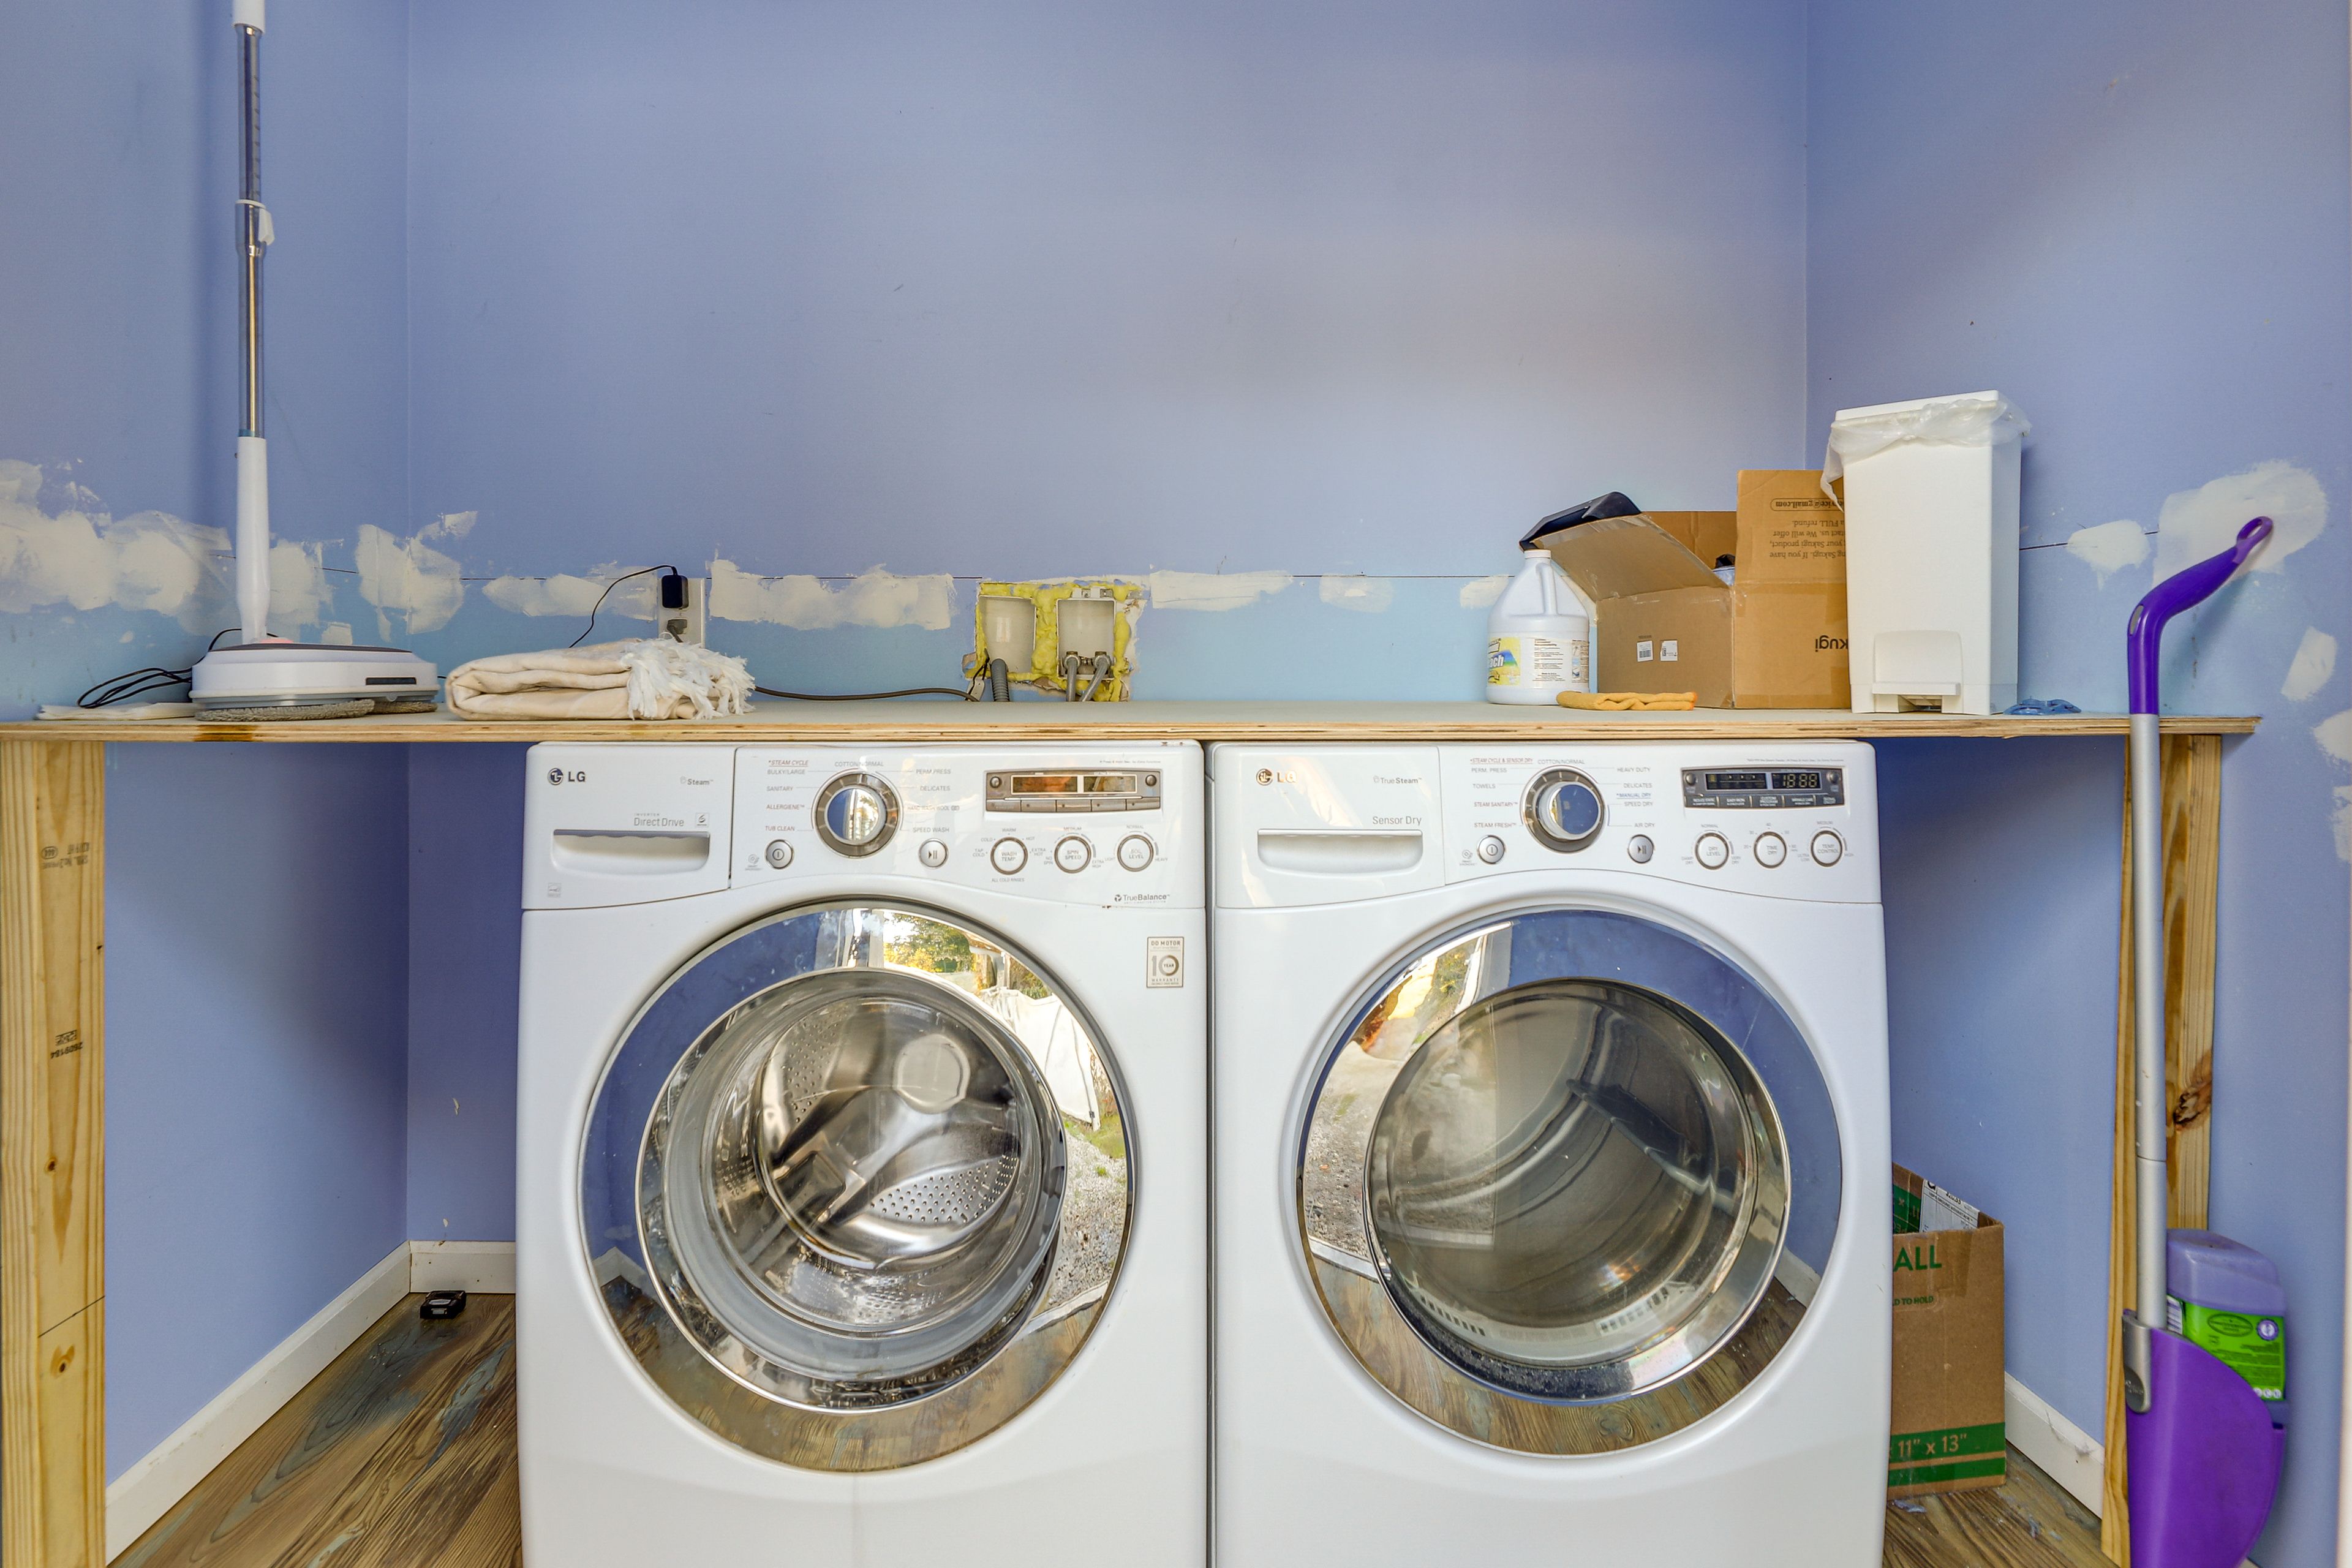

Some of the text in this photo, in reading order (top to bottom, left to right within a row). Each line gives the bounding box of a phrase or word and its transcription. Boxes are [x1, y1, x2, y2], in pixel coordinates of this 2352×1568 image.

[1770, 540, 1799, 548] product,
[1801, 540, 1825, 548] Sakugi
[1810, 549, 1836, 559] Sakugi.
[568, 771, 586, 782] LG
[1277, 771, 1297, 783] LG
[1372, 816, 1422, 826] Sensor Dry
[1893, 1245, 1942, 1272] ALL
[1913, 1295, 1934, 1305] HOLD
[1898, 1433, 1967, 1457] 11" x 13"
